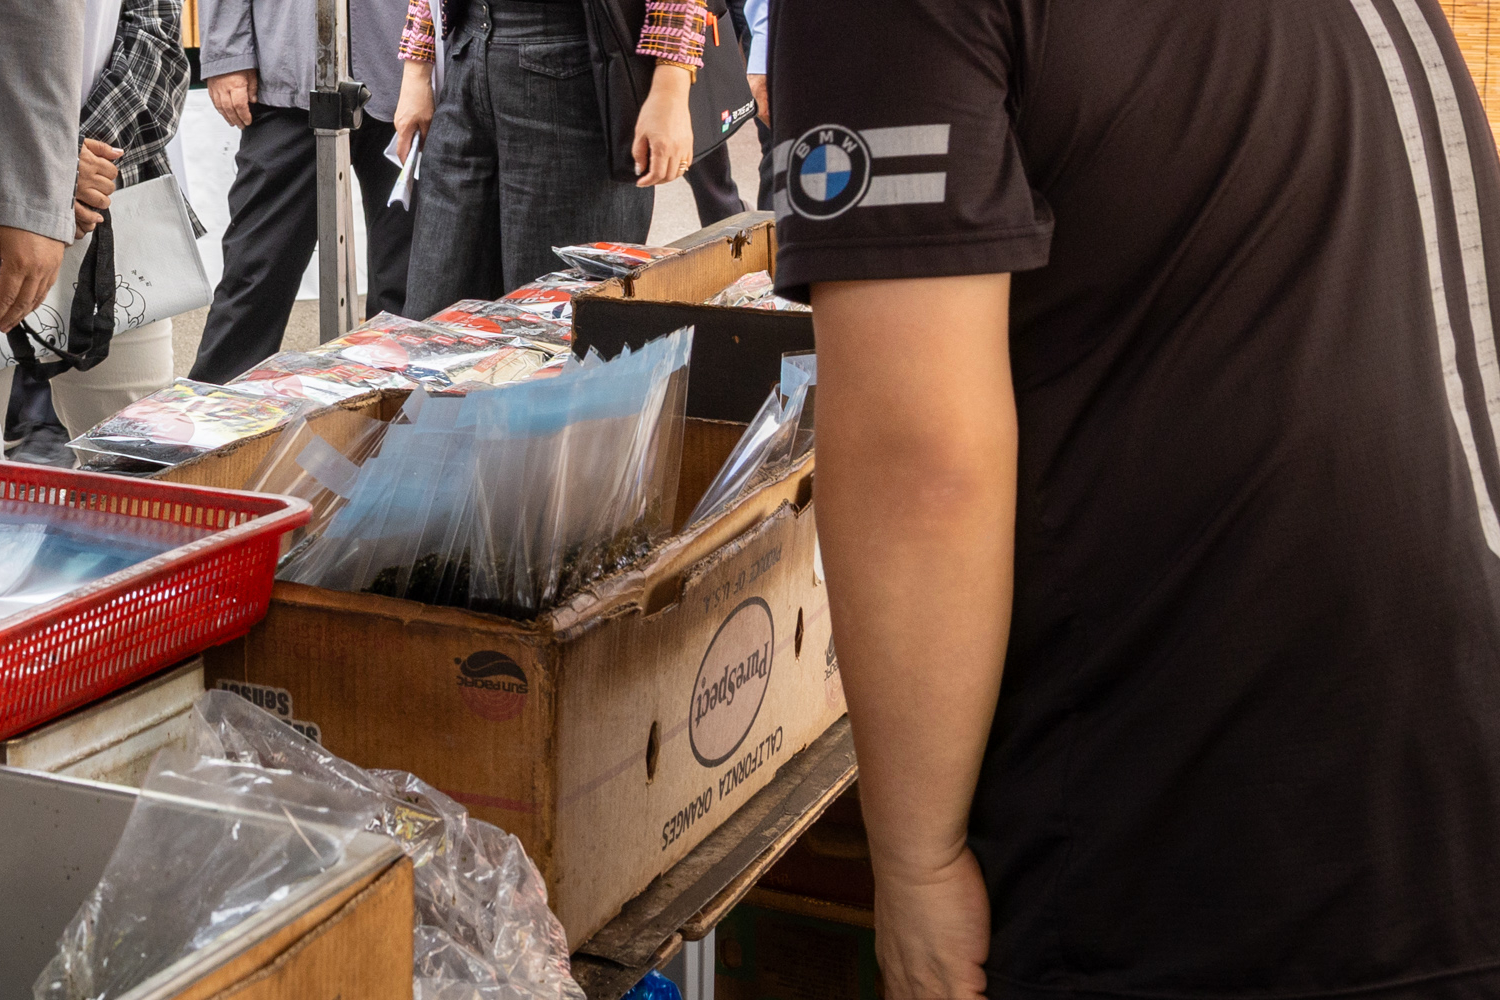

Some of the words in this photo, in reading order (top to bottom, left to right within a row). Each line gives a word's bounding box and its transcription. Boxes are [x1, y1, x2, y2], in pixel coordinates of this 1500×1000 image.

[796, 130, 858, 159] BMW
[694, 640, 770, 729] PureSpect
[718, 725, 784, 802] CALIFORNIA
[661, 785, 714, 852] ORANGES
